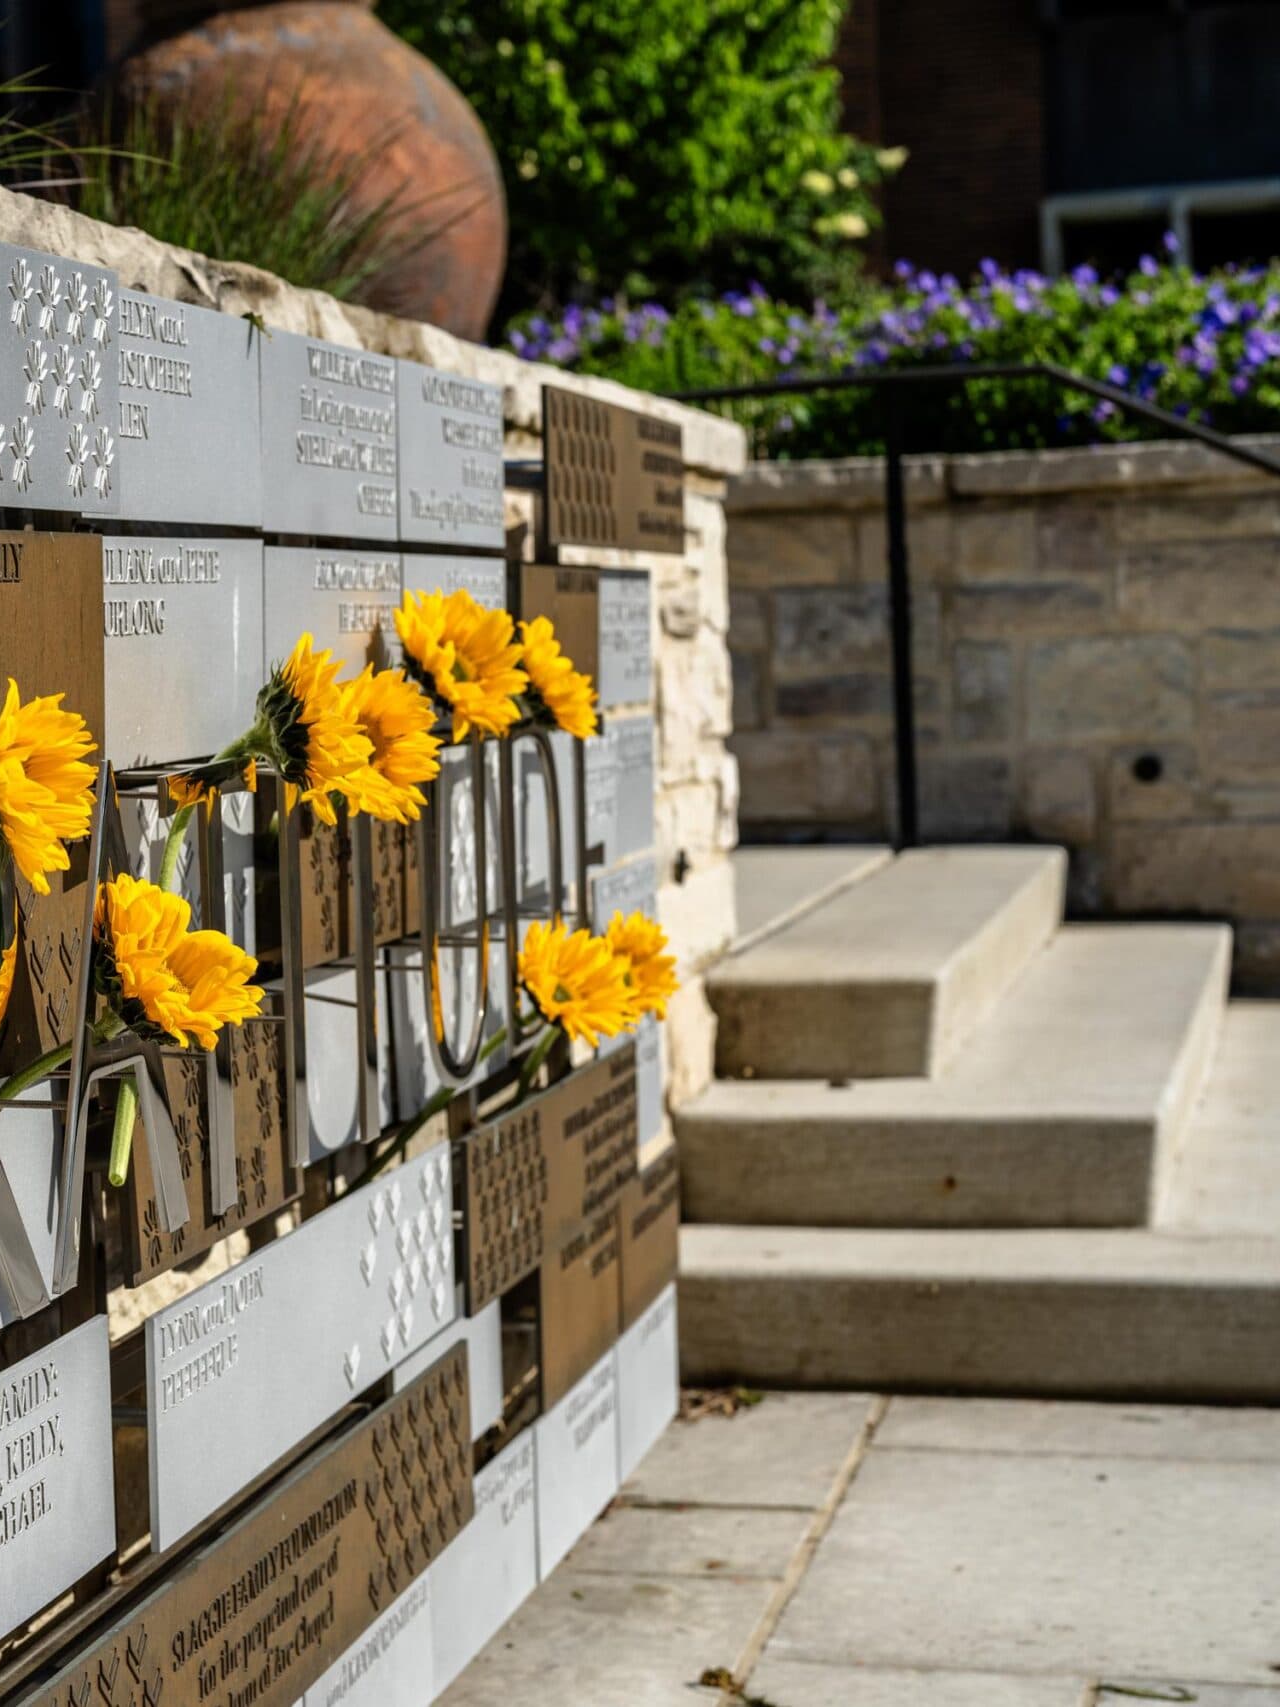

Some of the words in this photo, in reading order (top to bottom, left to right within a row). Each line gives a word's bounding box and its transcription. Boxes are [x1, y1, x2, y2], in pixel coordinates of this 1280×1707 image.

[159, 308, 189, 348] and
[157, 544, 186, 585] and
[185, 549, 221, 585] PETE
[159, 1304, 200, 1363] LYNN
[201, 1285, 229, 1336] and
[228, 1265, 264, 1325] JOHN
[5, 1412, 65, 1486] KELLY,
[231, 1545, 278, 1610] FAMILY
[278, 1477, 358, 1573] FOUNDATION
[294, 1589, 335, 1657] Chapel
[197, 1659, 217, 1704] for
[218, 1639, 241, 1681] the
